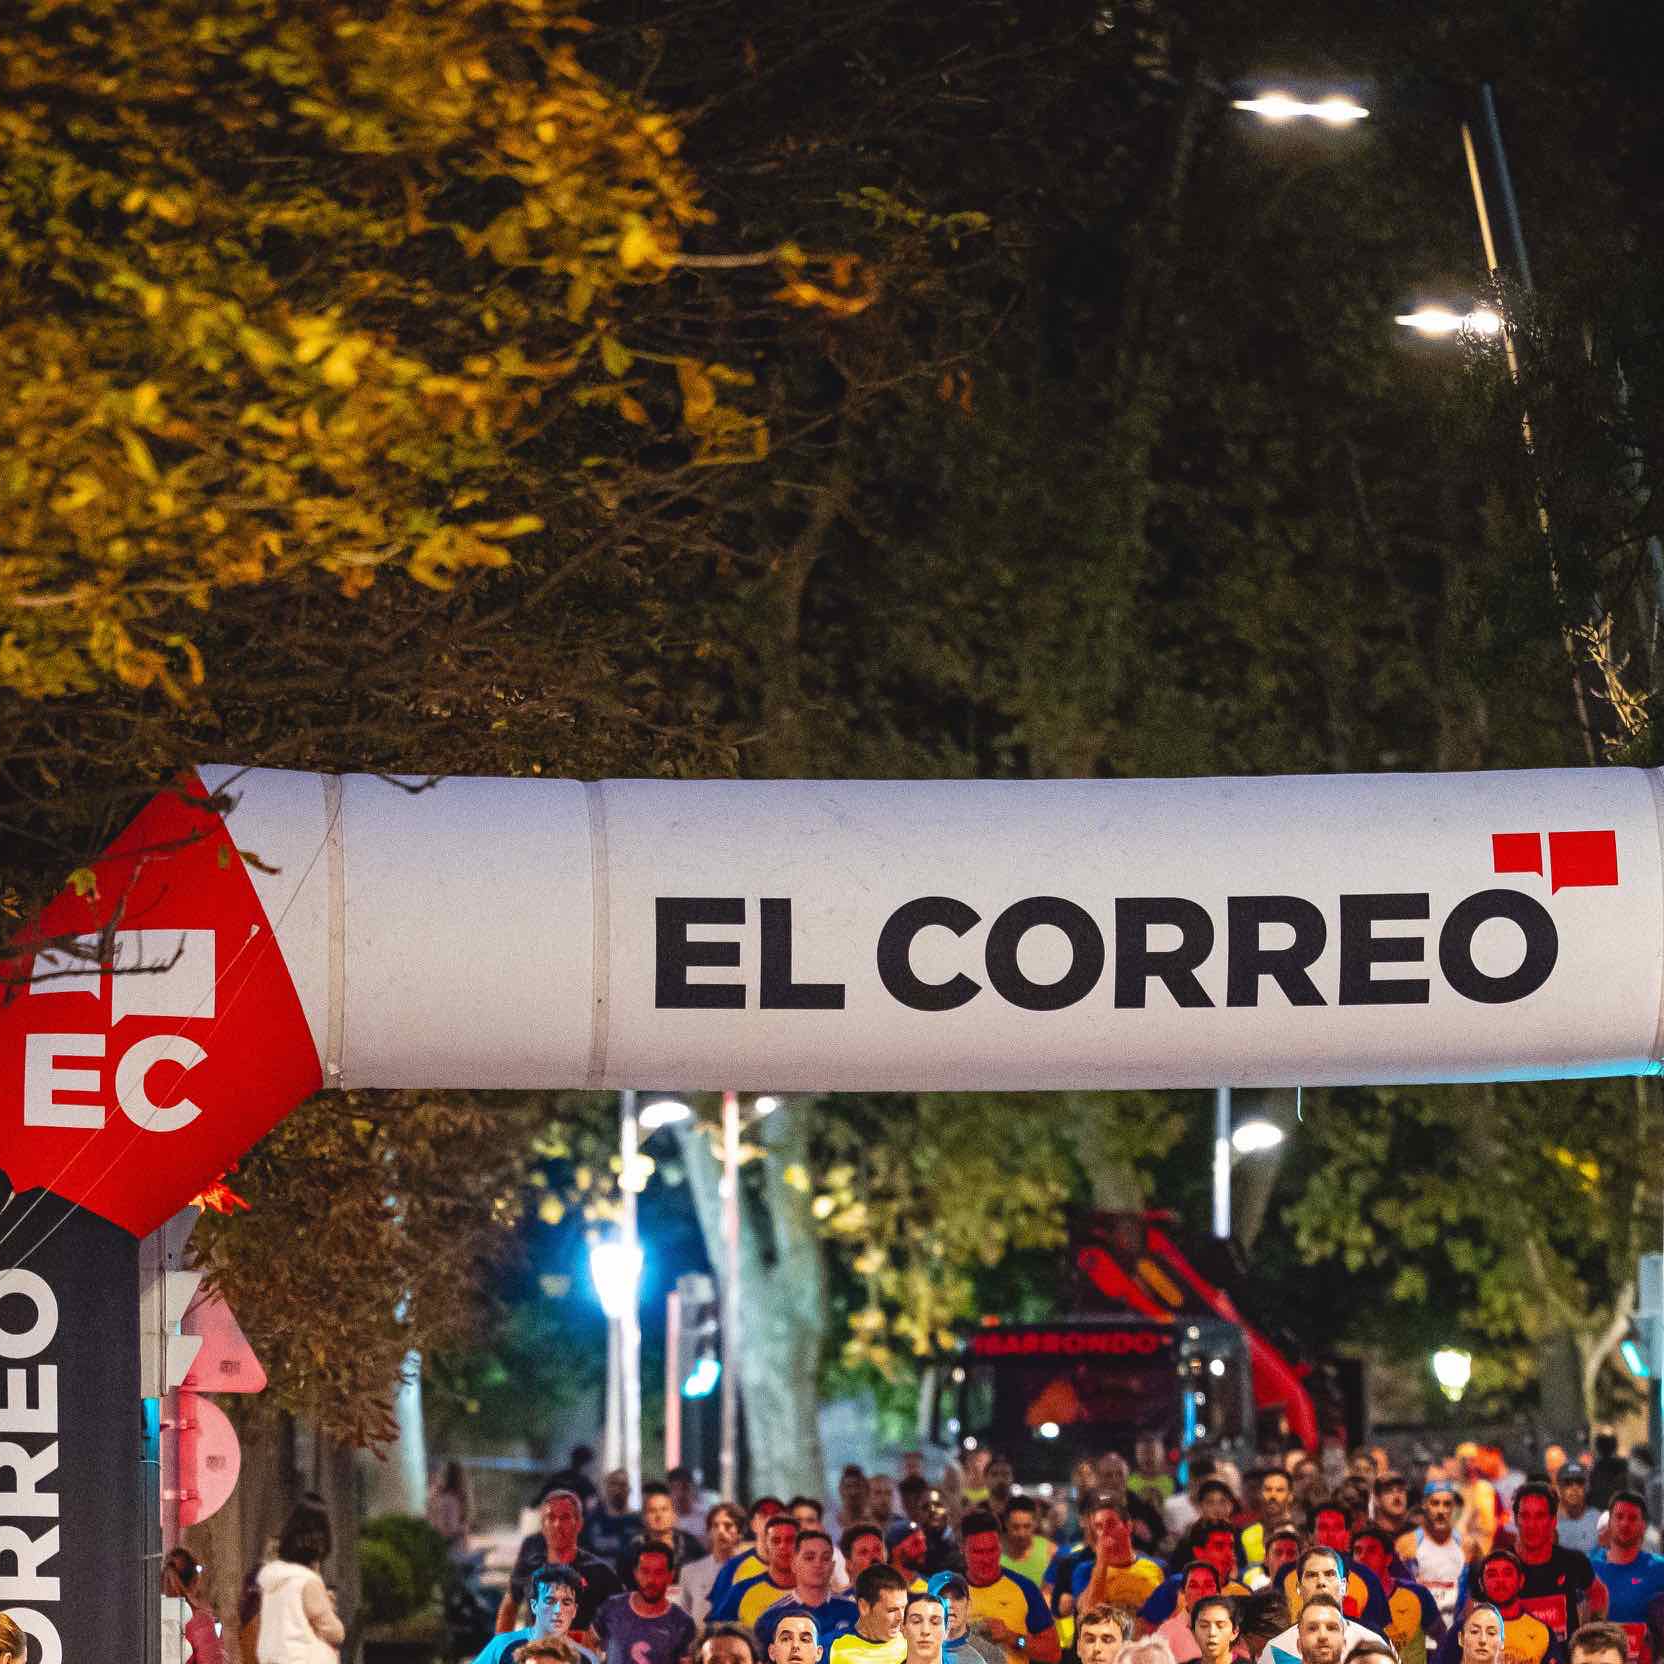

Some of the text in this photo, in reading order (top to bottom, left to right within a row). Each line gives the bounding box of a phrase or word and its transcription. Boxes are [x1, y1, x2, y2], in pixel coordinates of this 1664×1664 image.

[654, 887, 1559, 1012] EL CORREO
[23, 1031, 208, 1132] EC
